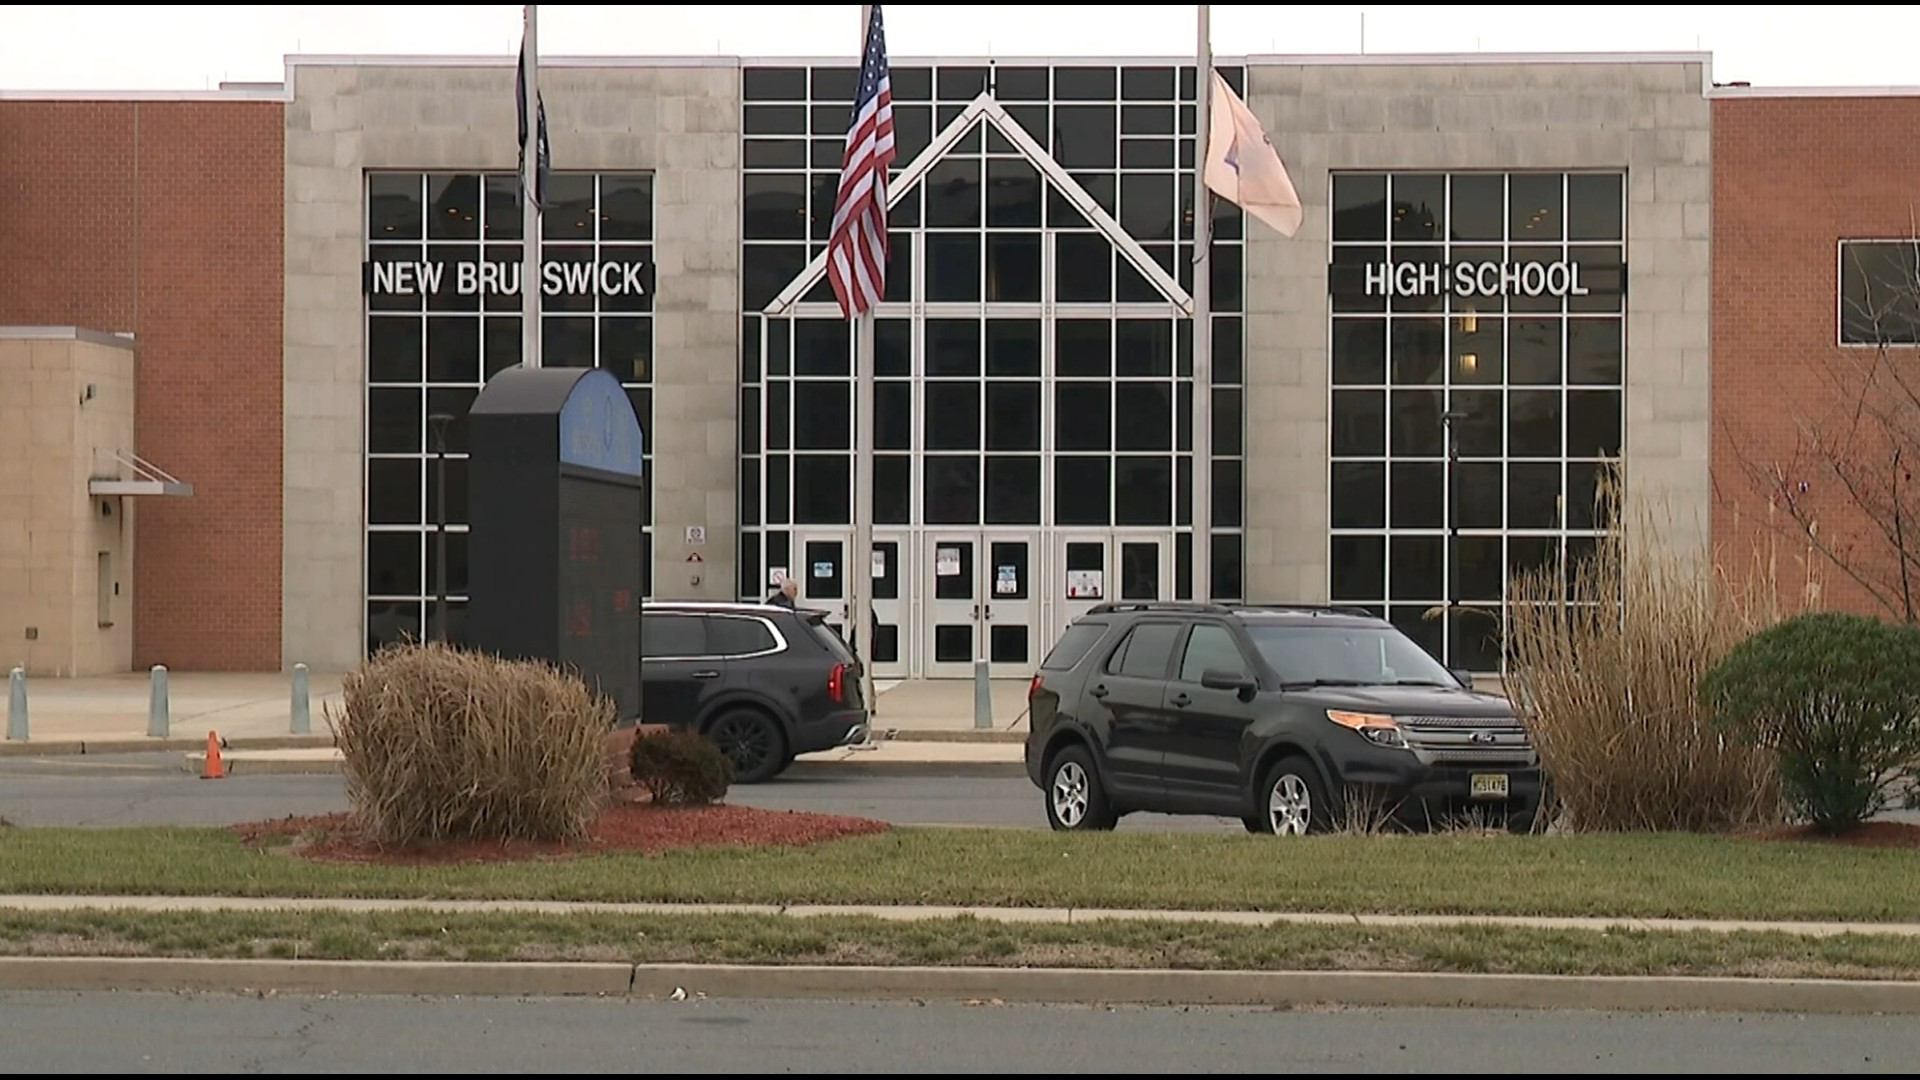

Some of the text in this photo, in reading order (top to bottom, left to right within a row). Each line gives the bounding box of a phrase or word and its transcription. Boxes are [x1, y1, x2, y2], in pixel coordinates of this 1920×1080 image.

[373, 261, 644, 295] NEW BRUSWICK
[1365, 261, 1589, 296] HIGH SCHOOL
